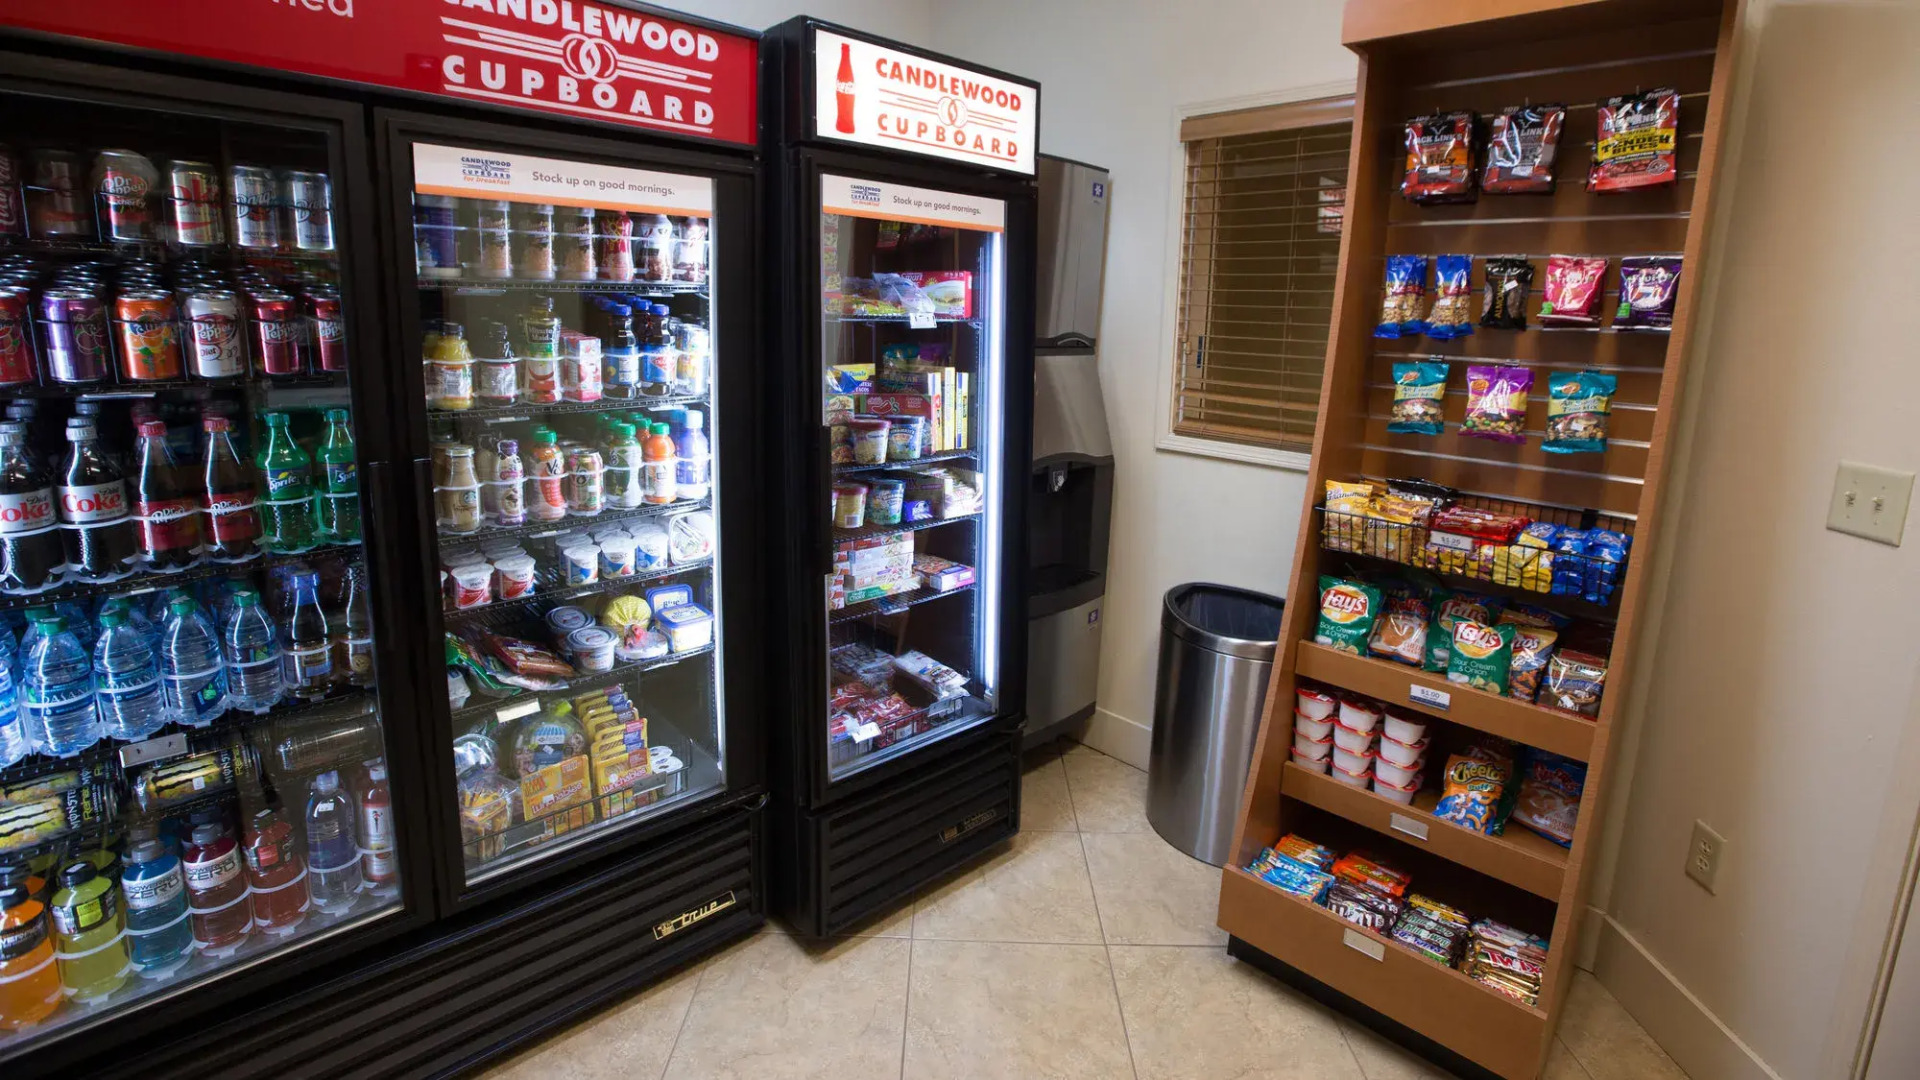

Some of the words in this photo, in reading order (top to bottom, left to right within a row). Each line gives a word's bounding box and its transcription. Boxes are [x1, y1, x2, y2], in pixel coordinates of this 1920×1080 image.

[441, 0, 719, 61] NDLEWOOD
[442, 56, 714, 125] CUPBOARD
[876, 58, 1021, 111] CANDLEWOOD
[878, 114, 1018, 156] CUPBOARD
[461, 157, 511, 167] CANDLEWOOD
[532, 171, 563, 184] Stock
[566, 178, 579, 187] up
[599, 180, 625, 192] good
[628, 183, 675, 196] mornings.
[893, 195, 912, 205] Stock
[913, 200, 923, 208] up
[934, 202, 950, 211] good
[952, 205, 981, 215] mornings.
[0, 501, 50, 523] oke
[61, 492, 122, 513] Coke
[1323, 590, 1366, 613] Lay's
[1320, 621, 1335, 631] Sour
[1336, 625, 1357, 636] Cream
[1330, 630, 1349, 640] Onion
[1455, 623, 1499, 649] Lay's
[1454, 656, 1469, 667] Sour
[1470, 660, 1497, 671] Cream
[1464, 665, 1488, 677] Onion
[532, 781, 583, 814] Lunhables
[188, 859, 237, 881] ZERO
[129, 877, 180, 900] ZERO
